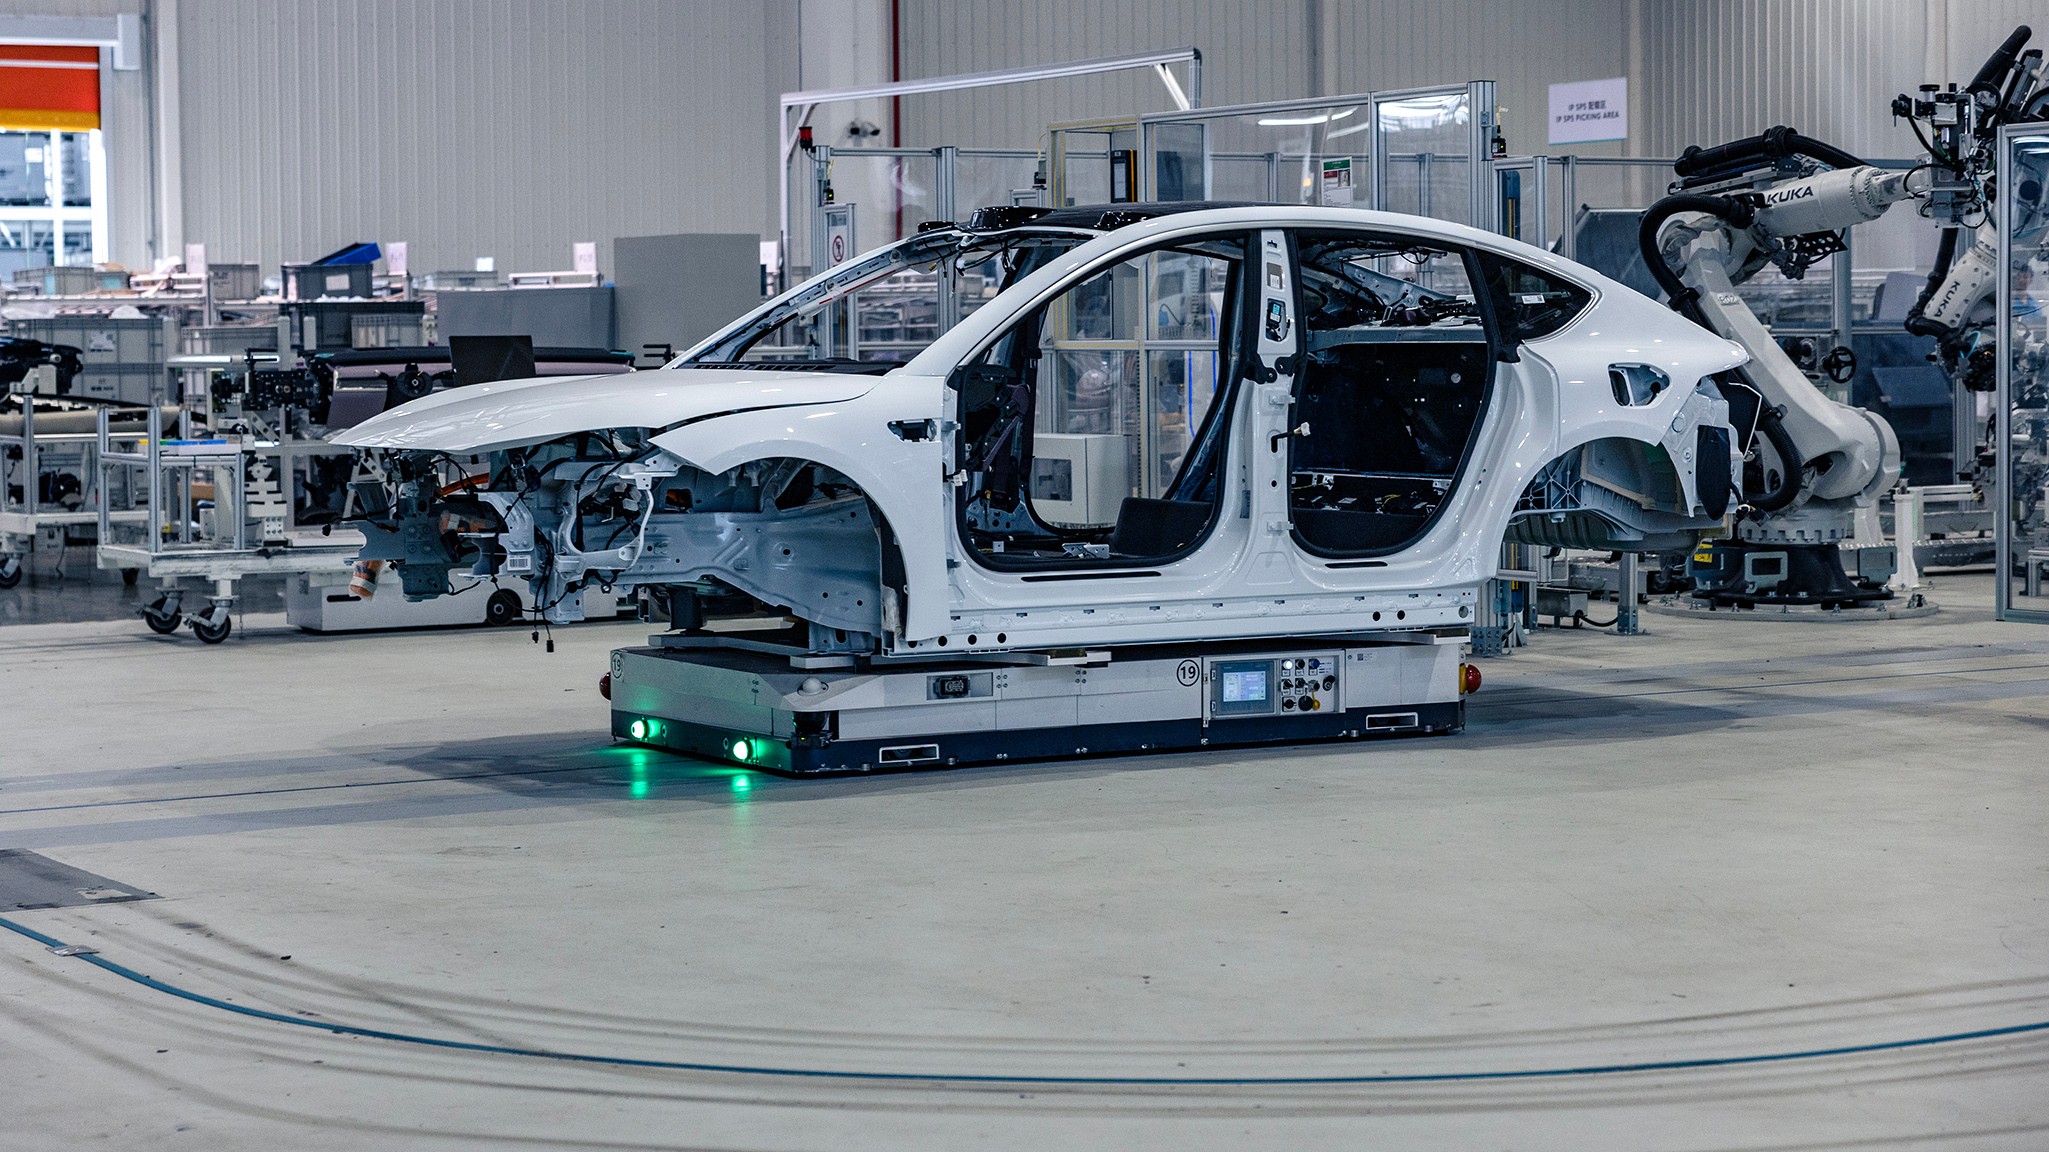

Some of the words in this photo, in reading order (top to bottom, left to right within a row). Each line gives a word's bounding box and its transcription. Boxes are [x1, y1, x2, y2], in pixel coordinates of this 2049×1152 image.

[1576, 113, 1601, 121] PICKING
[1767, 185, 1813, 204] KUKA
[1934, 281, 1960, 317] KUKA
[613, 659, 621, 671] 19
[1180, 665, 1196, 679] 19
